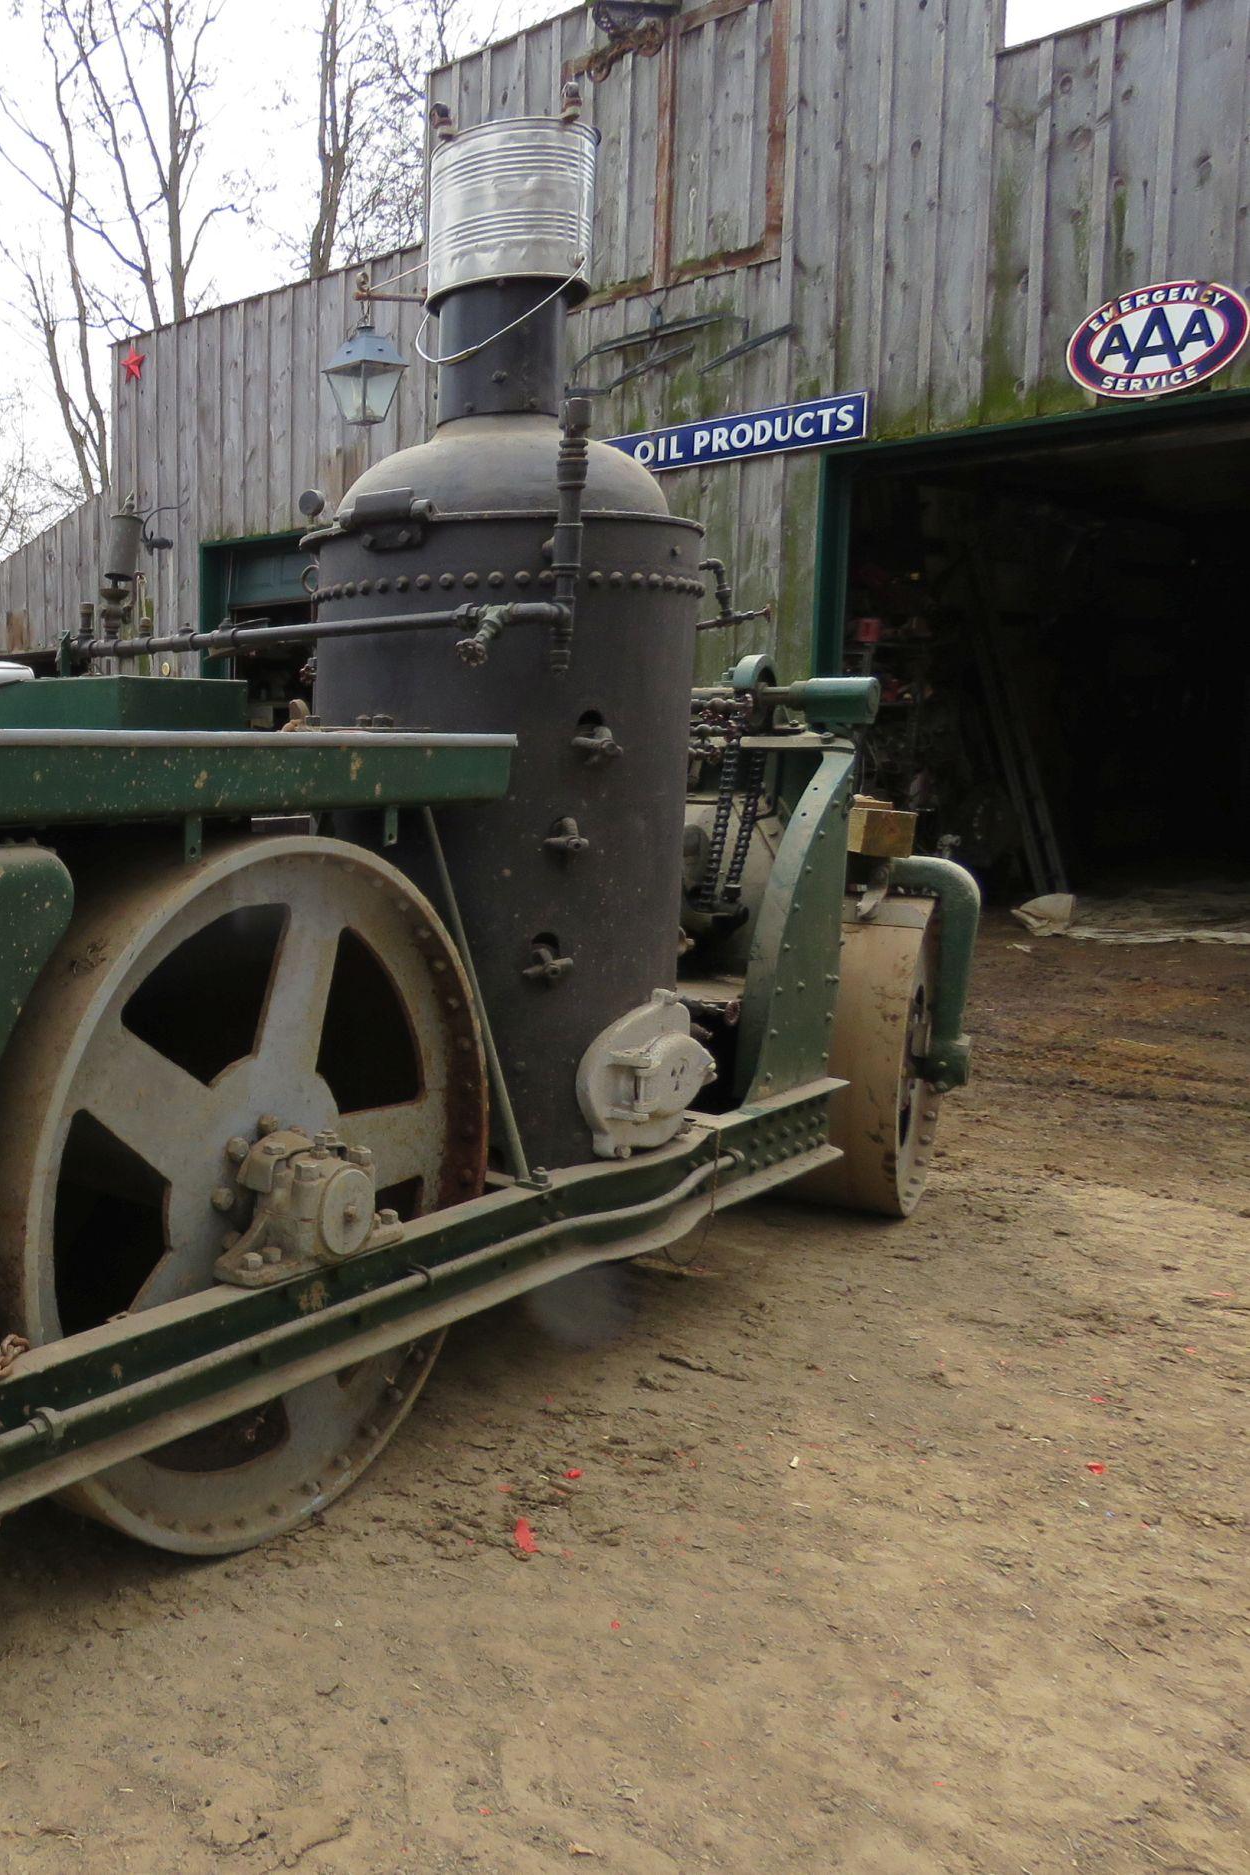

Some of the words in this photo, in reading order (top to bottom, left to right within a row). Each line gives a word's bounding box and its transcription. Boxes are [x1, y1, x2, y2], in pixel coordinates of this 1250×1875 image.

[1088, 287, 1227, 332] EMERGENCY
[1095, 307, 1216, 374] AAA
[1101, 365, 1198, 391] SERVICE
[634, 435, 683, 465] OIL
[693, 404, 855, 456] PRODUCTS
